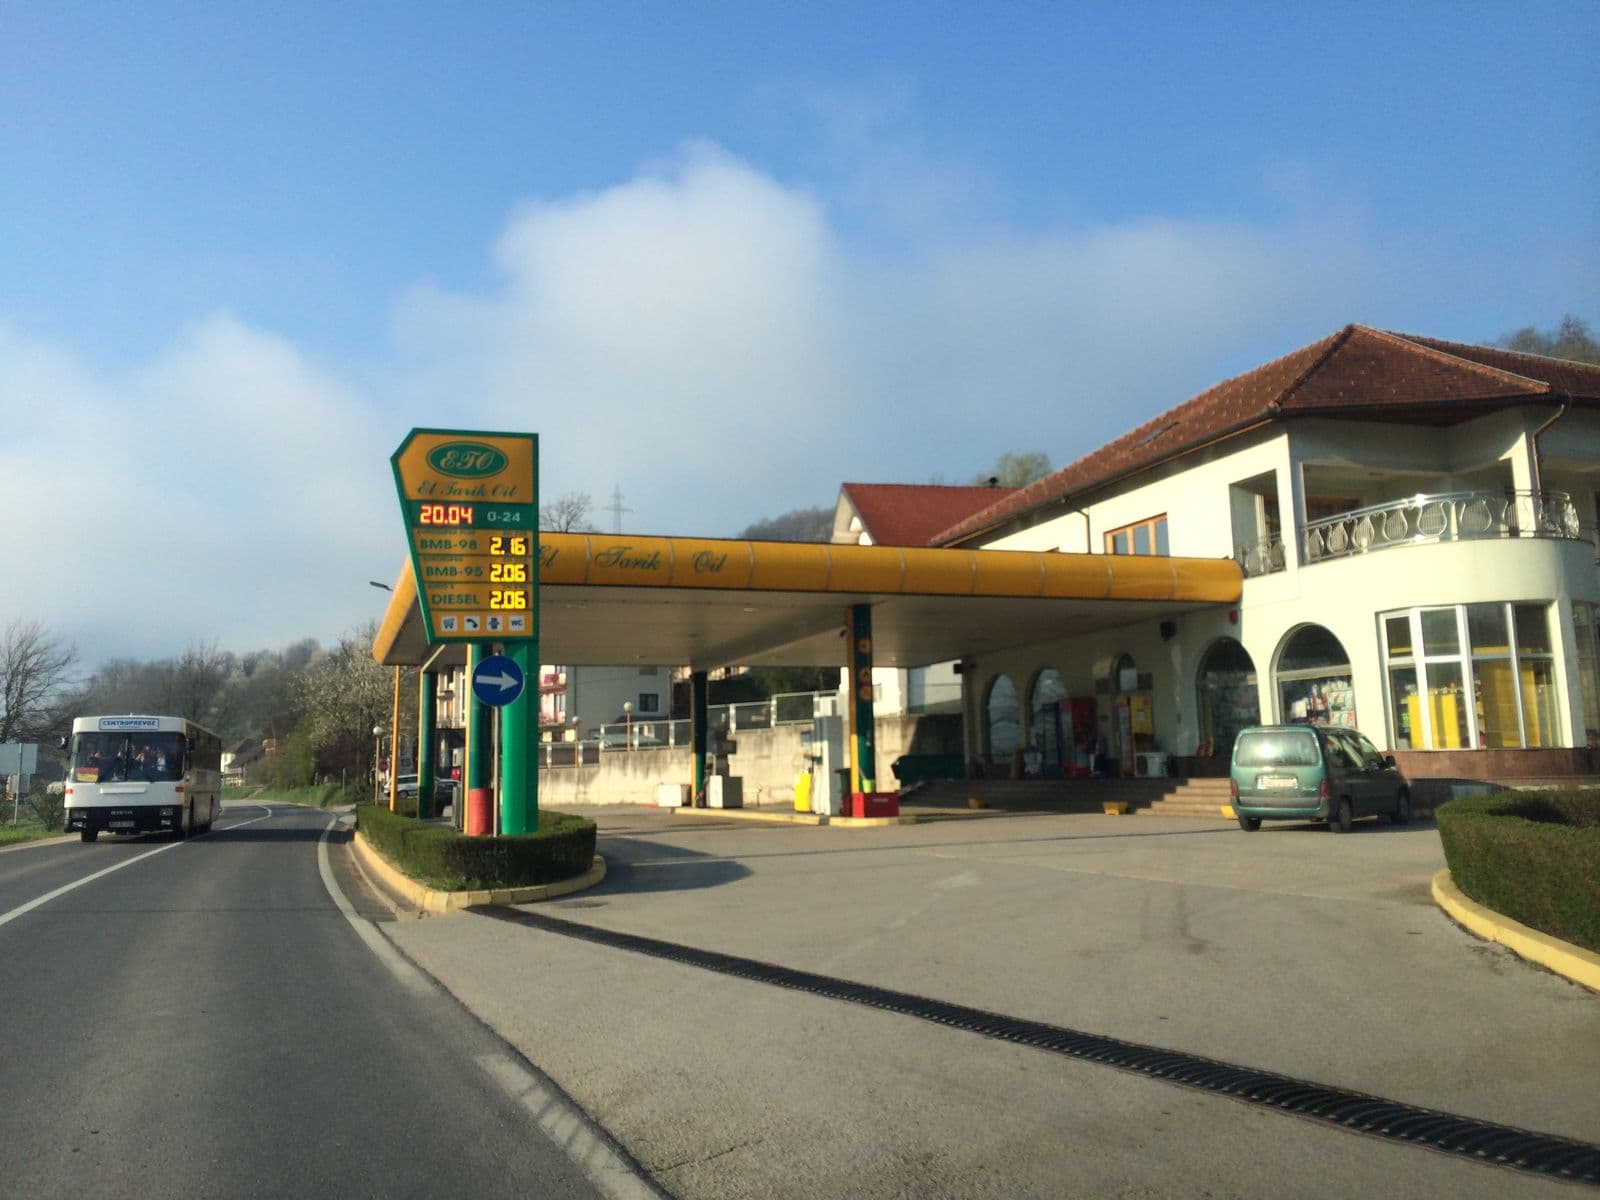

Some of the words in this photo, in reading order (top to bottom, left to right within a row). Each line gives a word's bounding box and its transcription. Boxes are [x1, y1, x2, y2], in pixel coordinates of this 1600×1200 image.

[420, 505, 473, 525] 20.04
[487, 511, 521, 522] 0-24
[420, 540, 478, 549] BMB-98
[594, 546, 663, 570] Tarik
[692, 551, 728, 573] Oil
[490, 564, 526, 582] 2.06
[431, 594, 480, 605] DIESEL
[490, 591, 526, 609] 2.06
